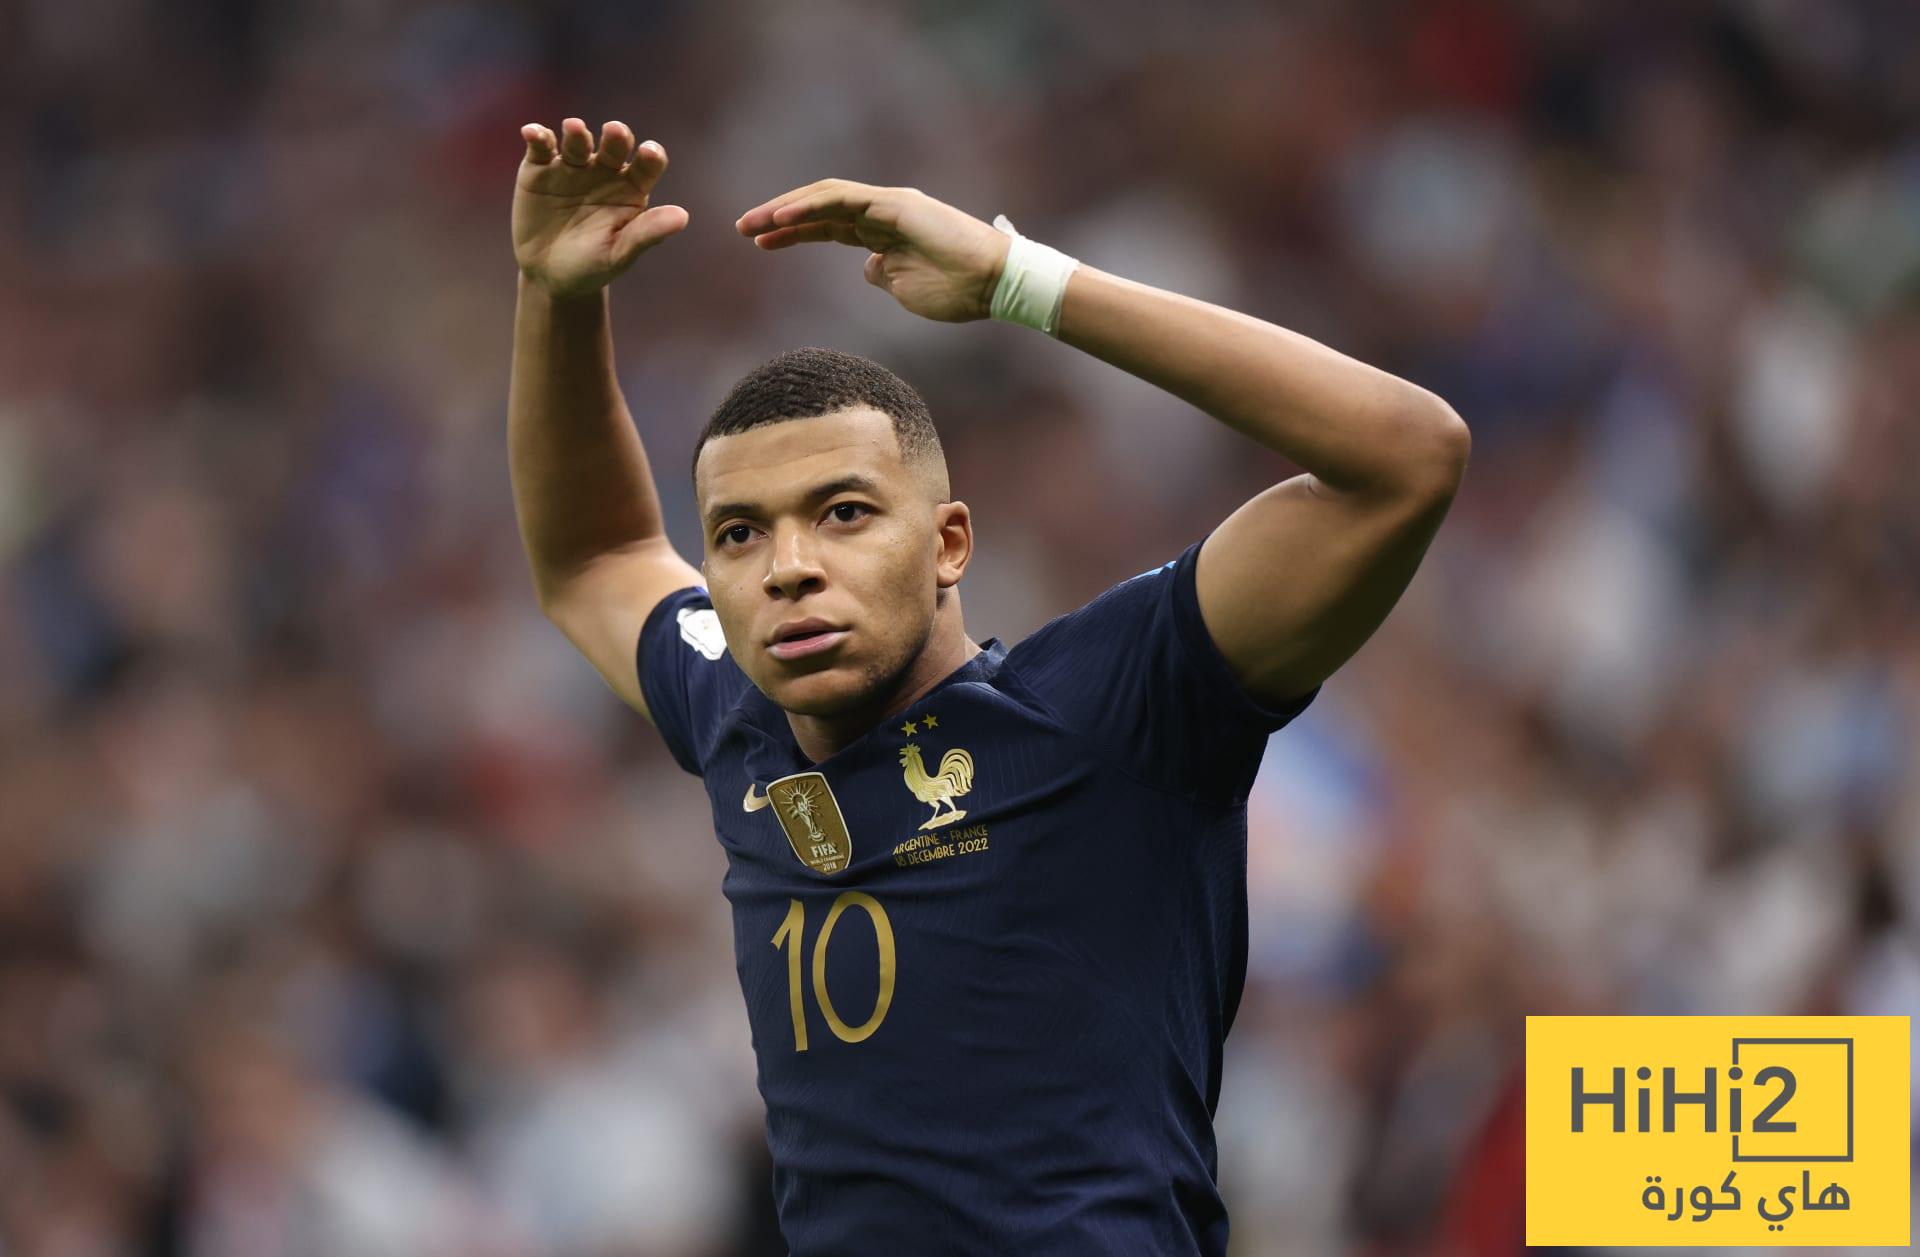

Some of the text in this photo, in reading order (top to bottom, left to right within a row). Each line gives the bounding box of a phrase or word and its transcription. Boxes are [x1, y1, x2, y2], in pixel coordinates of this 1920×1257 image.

[893, 833, 939, 855] ARGENTINE
[950, 824, 988, 841] FRANCE
[958, 837, 989, 855] 2022
[810, 843, 838, 858] FIFA
[823, 861, 837, 871] 2018
[770, 891, 896, 1052] 10
